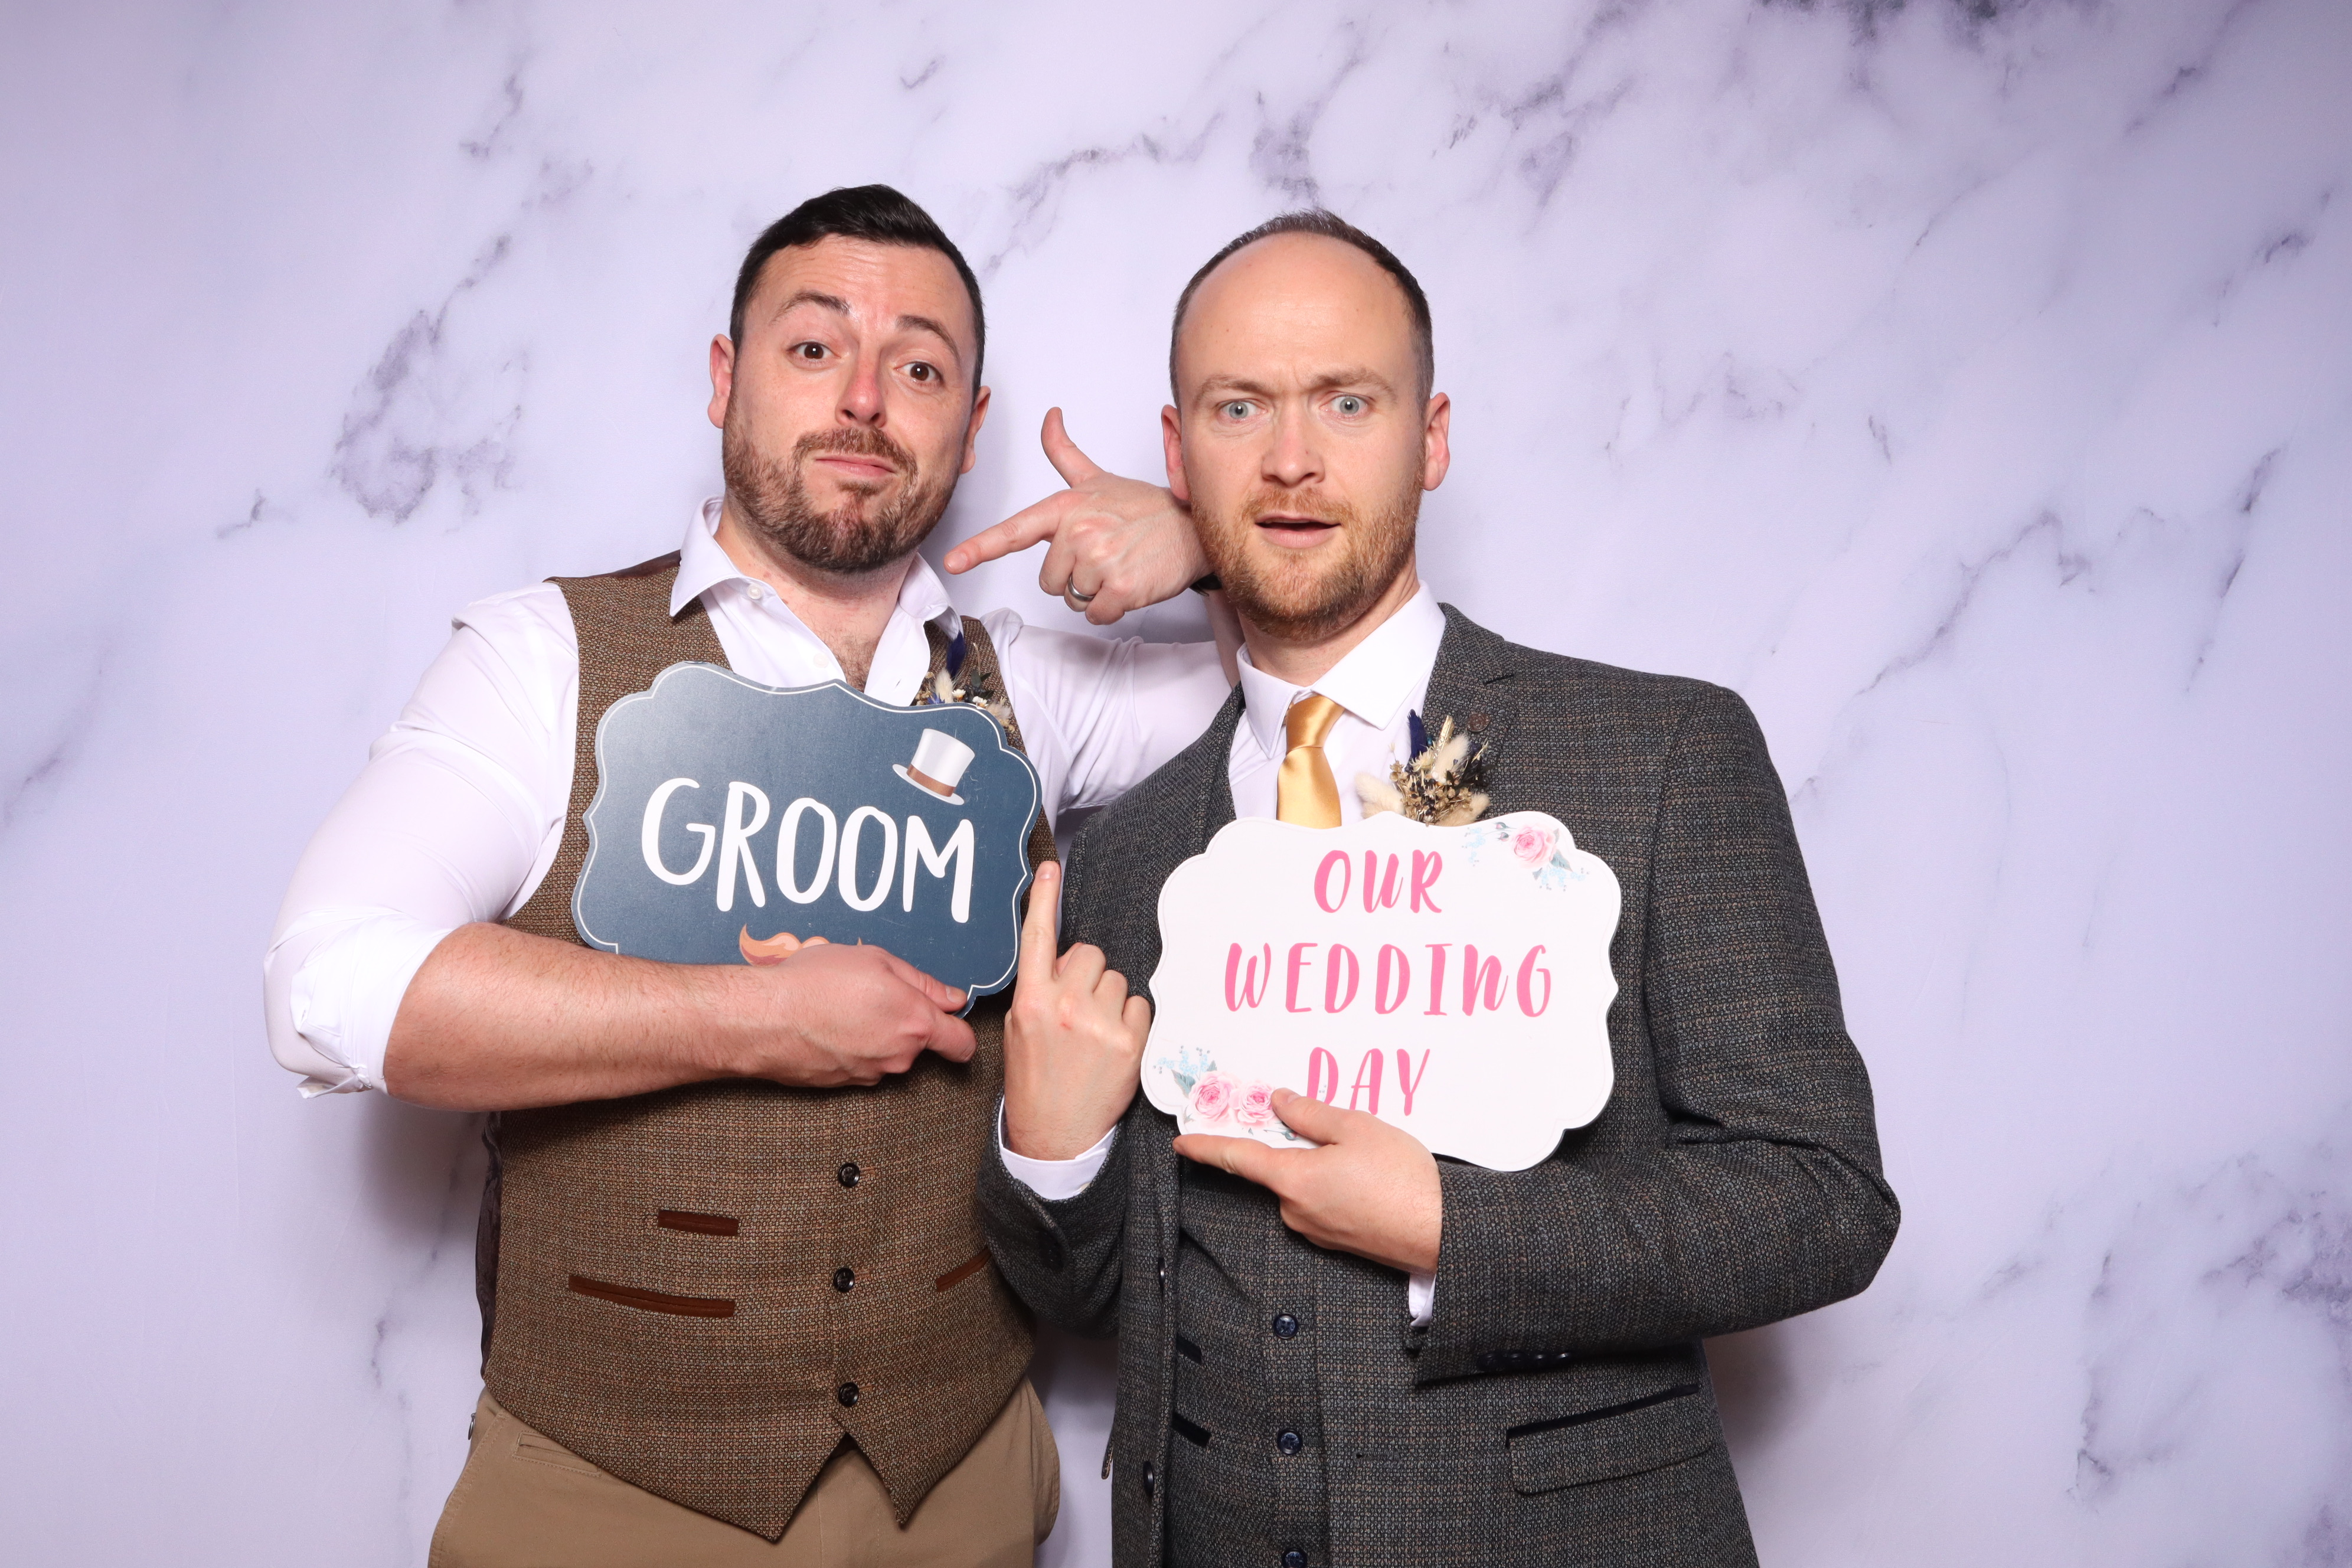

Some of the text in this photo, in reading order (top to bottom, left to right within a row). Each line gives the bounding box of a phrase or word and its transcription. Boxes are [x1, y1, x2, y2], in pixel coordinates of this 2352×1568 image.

[641, 777, 975, 923] GROOM
[1314, 849, 1443, 913] OUR
[1224, 942, 1551, 1017] WEDDING
[1306, 1046, 1431, 1117] DAY
